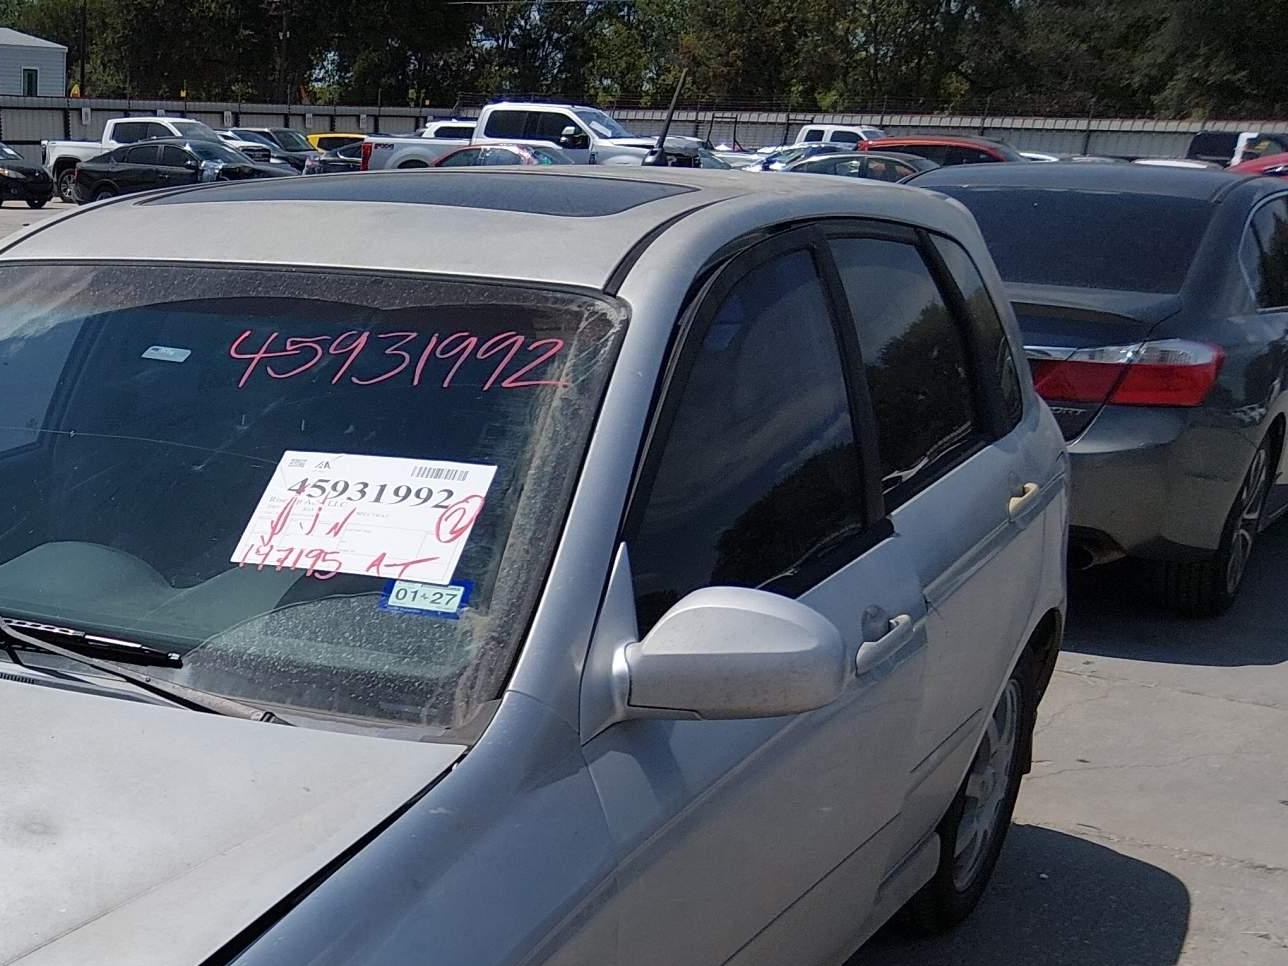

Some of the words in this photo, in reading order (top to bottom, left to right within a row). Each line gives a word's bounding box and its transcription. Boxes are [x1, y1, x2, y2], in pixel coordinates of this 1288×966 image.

[230, 330, 569, 391] 45931992
[288, 477, 454, 509] 45931992
[395, 588, 418, 602] 01
[430, 591, 458, 606] 27
